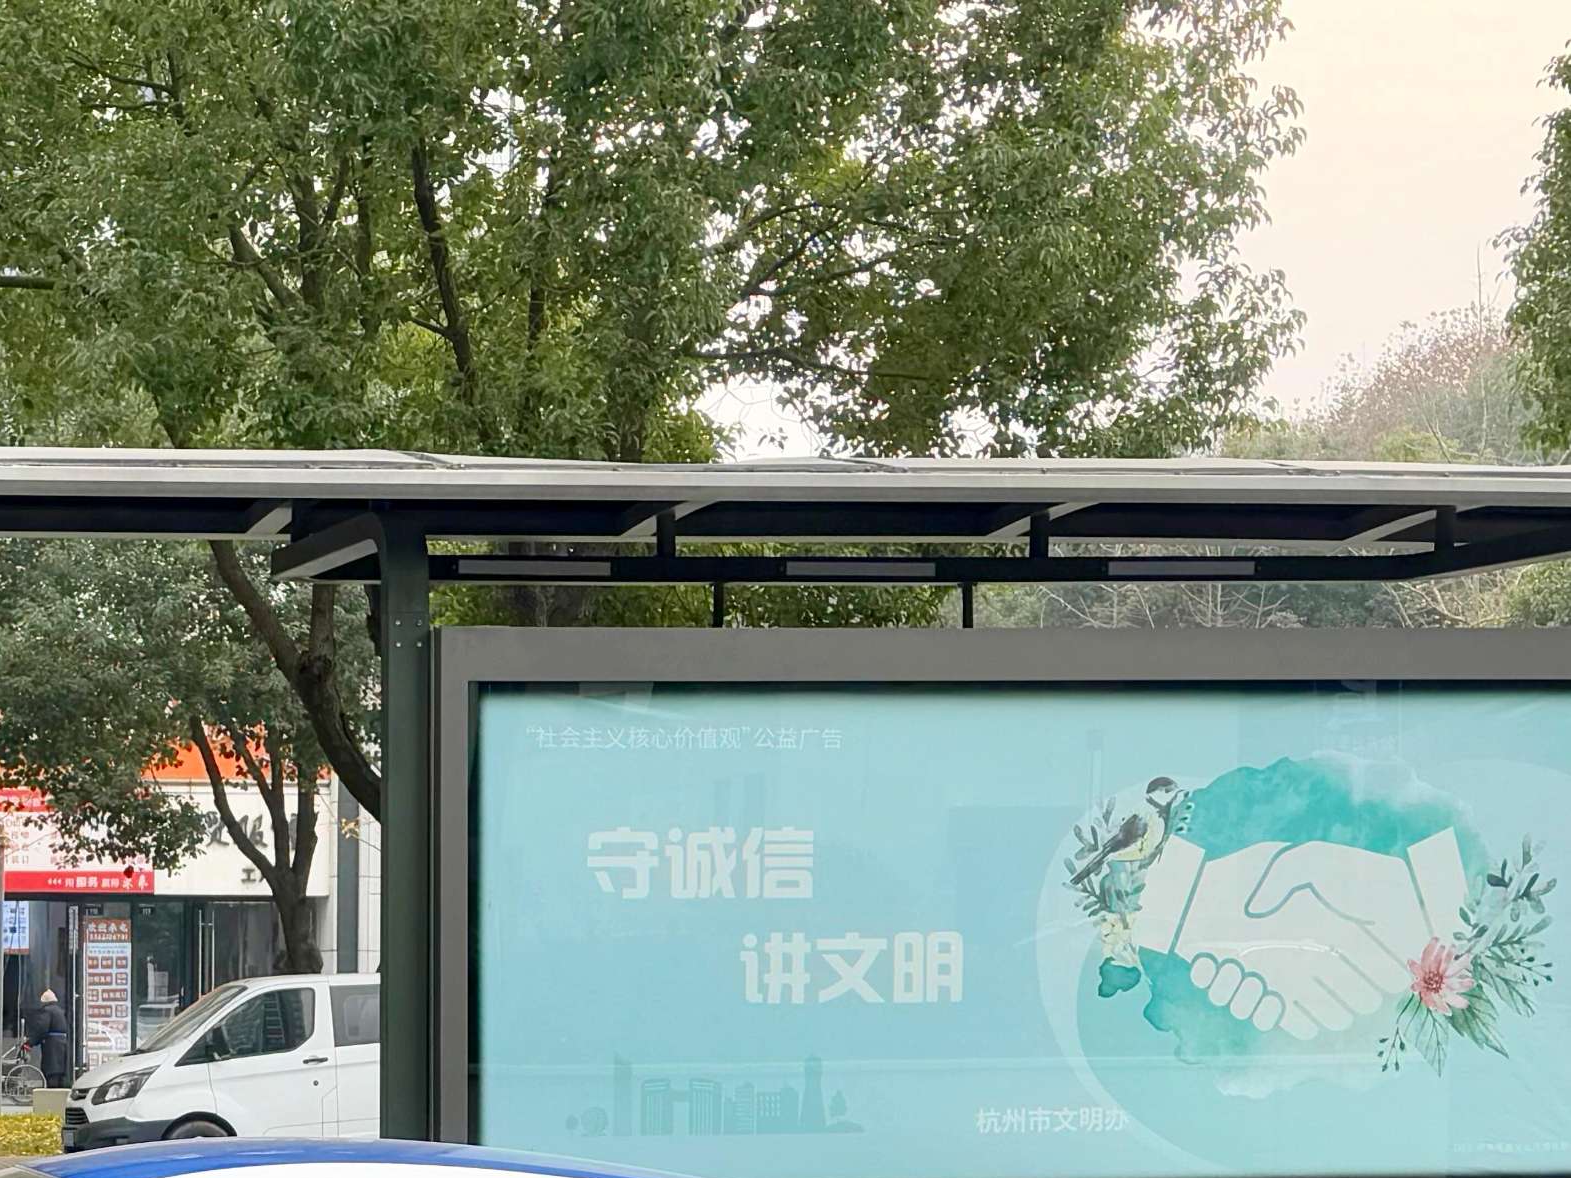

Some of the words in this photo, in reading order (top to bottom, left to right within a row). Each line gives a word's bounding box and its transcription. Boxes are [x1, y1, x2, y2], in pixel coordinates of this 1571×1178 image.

[587, 826, 814, 899] 守诚信
[740, 931, 964, 1004] 讲文明
[976, 1106, 1130, 1134] 杭州市文明办
